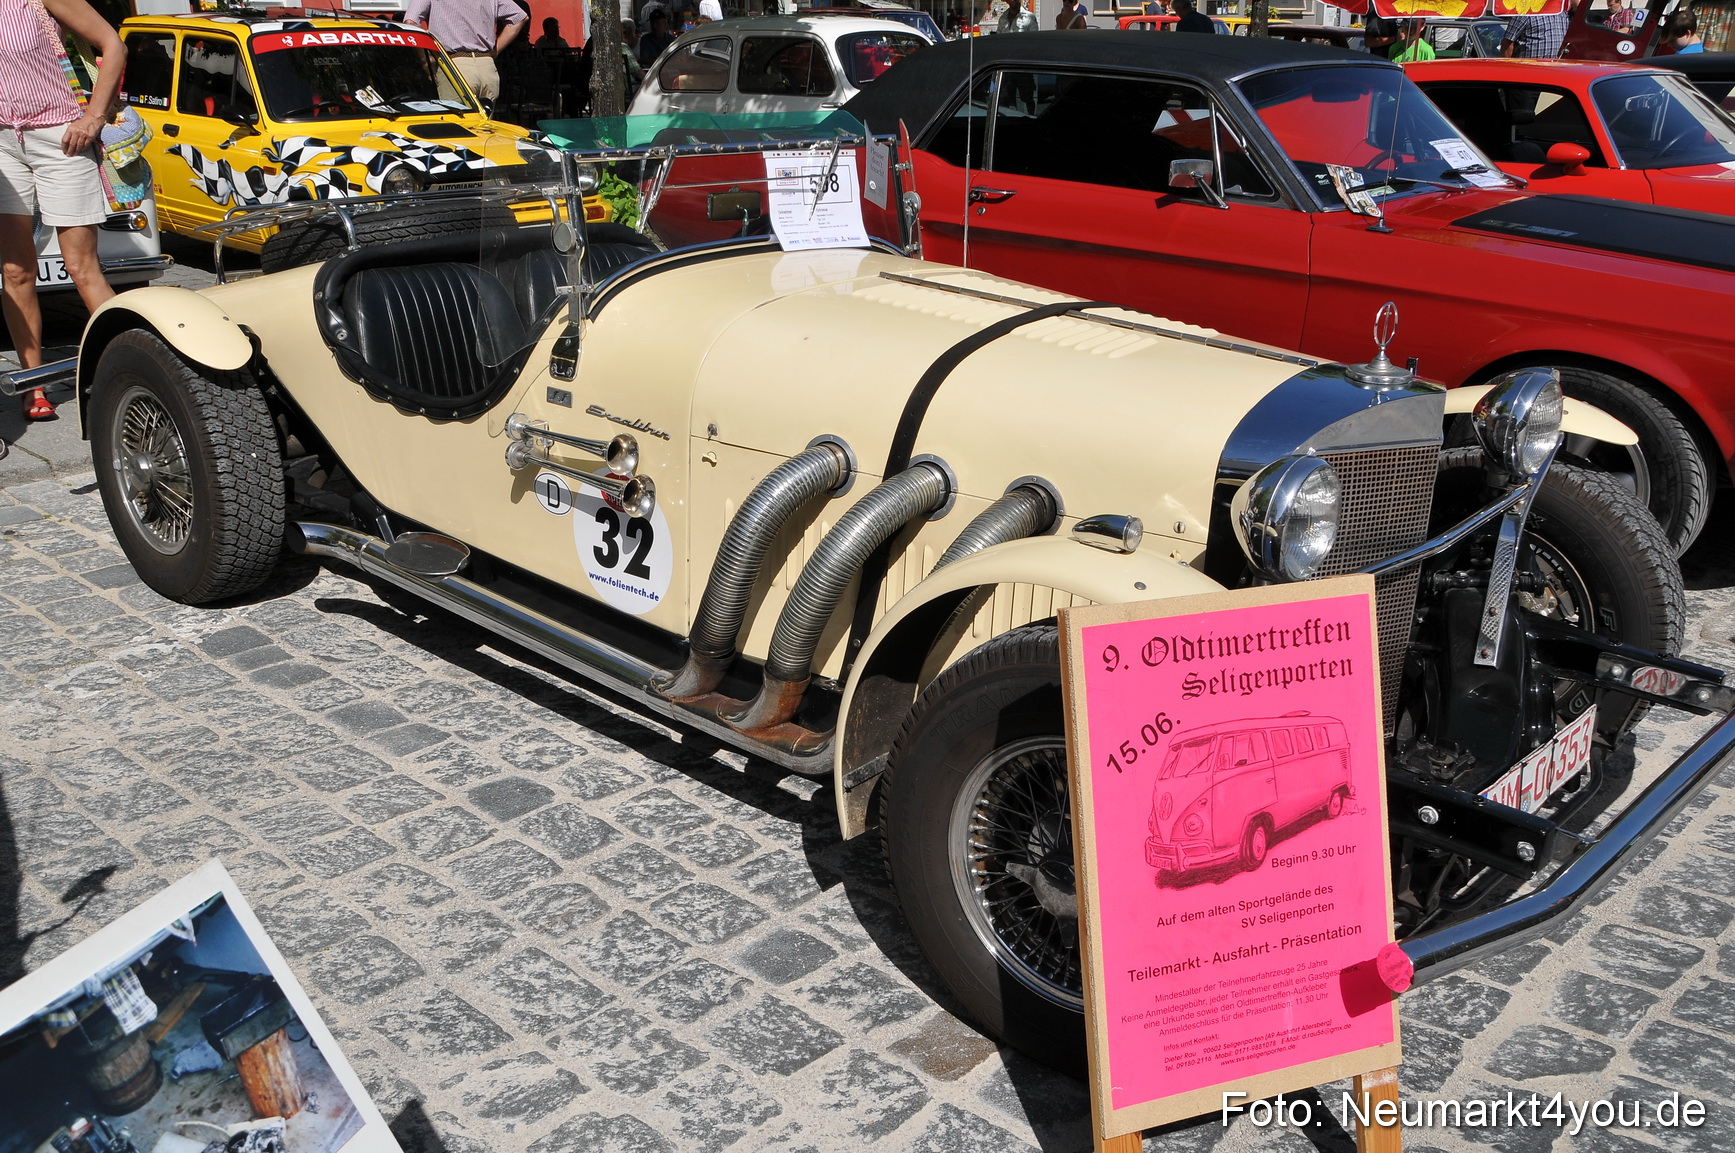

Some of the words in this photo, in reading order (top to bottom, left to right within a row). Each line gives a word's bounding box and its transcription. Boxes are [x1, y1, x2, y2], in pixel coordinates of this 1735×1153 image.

[302, 33, 405, 45] ABARTH
[1621, 43, 1630, 52] D
[547, 479, 560, 508] D
[593, 507, 654, 581] 32
[588, 571, 660, 602] www.folientech.de
[1102, 644, 1129, 673] 9.
[1141, 618, 1351, 667] Oldtimertreffen
[1181, 658, 1354, 700] Seligenporten
[1106, 711, 1181, 774] 15.06.
[1271, 855, 1309, 869] Beginn
[1311, 847, 1335, 861] 9.30
[1337, 843, 1357, 857] Uhr
[1156, 914, 1178, 927] Auf
[1180, 908, 1205, 923] dem
[1208, 903, 1235, 917] alten
[1238, 889, 1312, 913] Sportgelände
[1314, 884, 1334, 895] des
[1241, 916, 1256, 929] SV
[1259, 901, 1335, 926] Seligenporten
[1127, 957, 1201, 983] Teilemarkt
[1212, 941, 1270, 965] Ausfahrt
[1281, 922, 1362, 950] Präsentation
[1121, 1012, 1144, 1024] Keine
[1209, 993, 1229, 1006] jeder
[1231, 984, 1271, 999] Teilnehmer
[1272, 978, 1294, 990] erhält
[1295, 976, 1307, 985] ein
[1155, 985, 1202, 1003] Mindestalter
[1203, 983, 1216, 992] der
[1218, 967, 1295, 989] Teilnehmerfahrzeuge
[1296, 963, 1306, 972] 25
[1308, 959, 1328, 970] Jahre
[1143, 1019, 1161, 1030] eine
[1162, 1011, 1195, 1025] Urkunde
[1196, 1006, 1219, 1017] sowie
[1220, 1002, 1235, 1012] den
[1236, 982, 1328, 1009] Oldtimertreffen-Aufkleber
[1159, 1017, 1220, 1037] Anmeldeschluss
[1221, 1013, 1232, 1022] für
[1233, 1011, 1244, 1020] die
[1295, 995, 1315, 1006] 11.30
[1315, 992, 1329, 1001] Uhr
[1163, 1043, 1180, 1052] Infos
[1180, 1040, 1193, 1048] und
[1193, 1033, 1220, 1044] Kontakt:
[1164, 1053, 1183, 1064] Dieter
[1222, 1035, 1265, 1050] Seligenporten
[1276, 1026, 1301, 1038] Ausfahrt
[1301, 1018, 1333, 1031] Allersberg)
